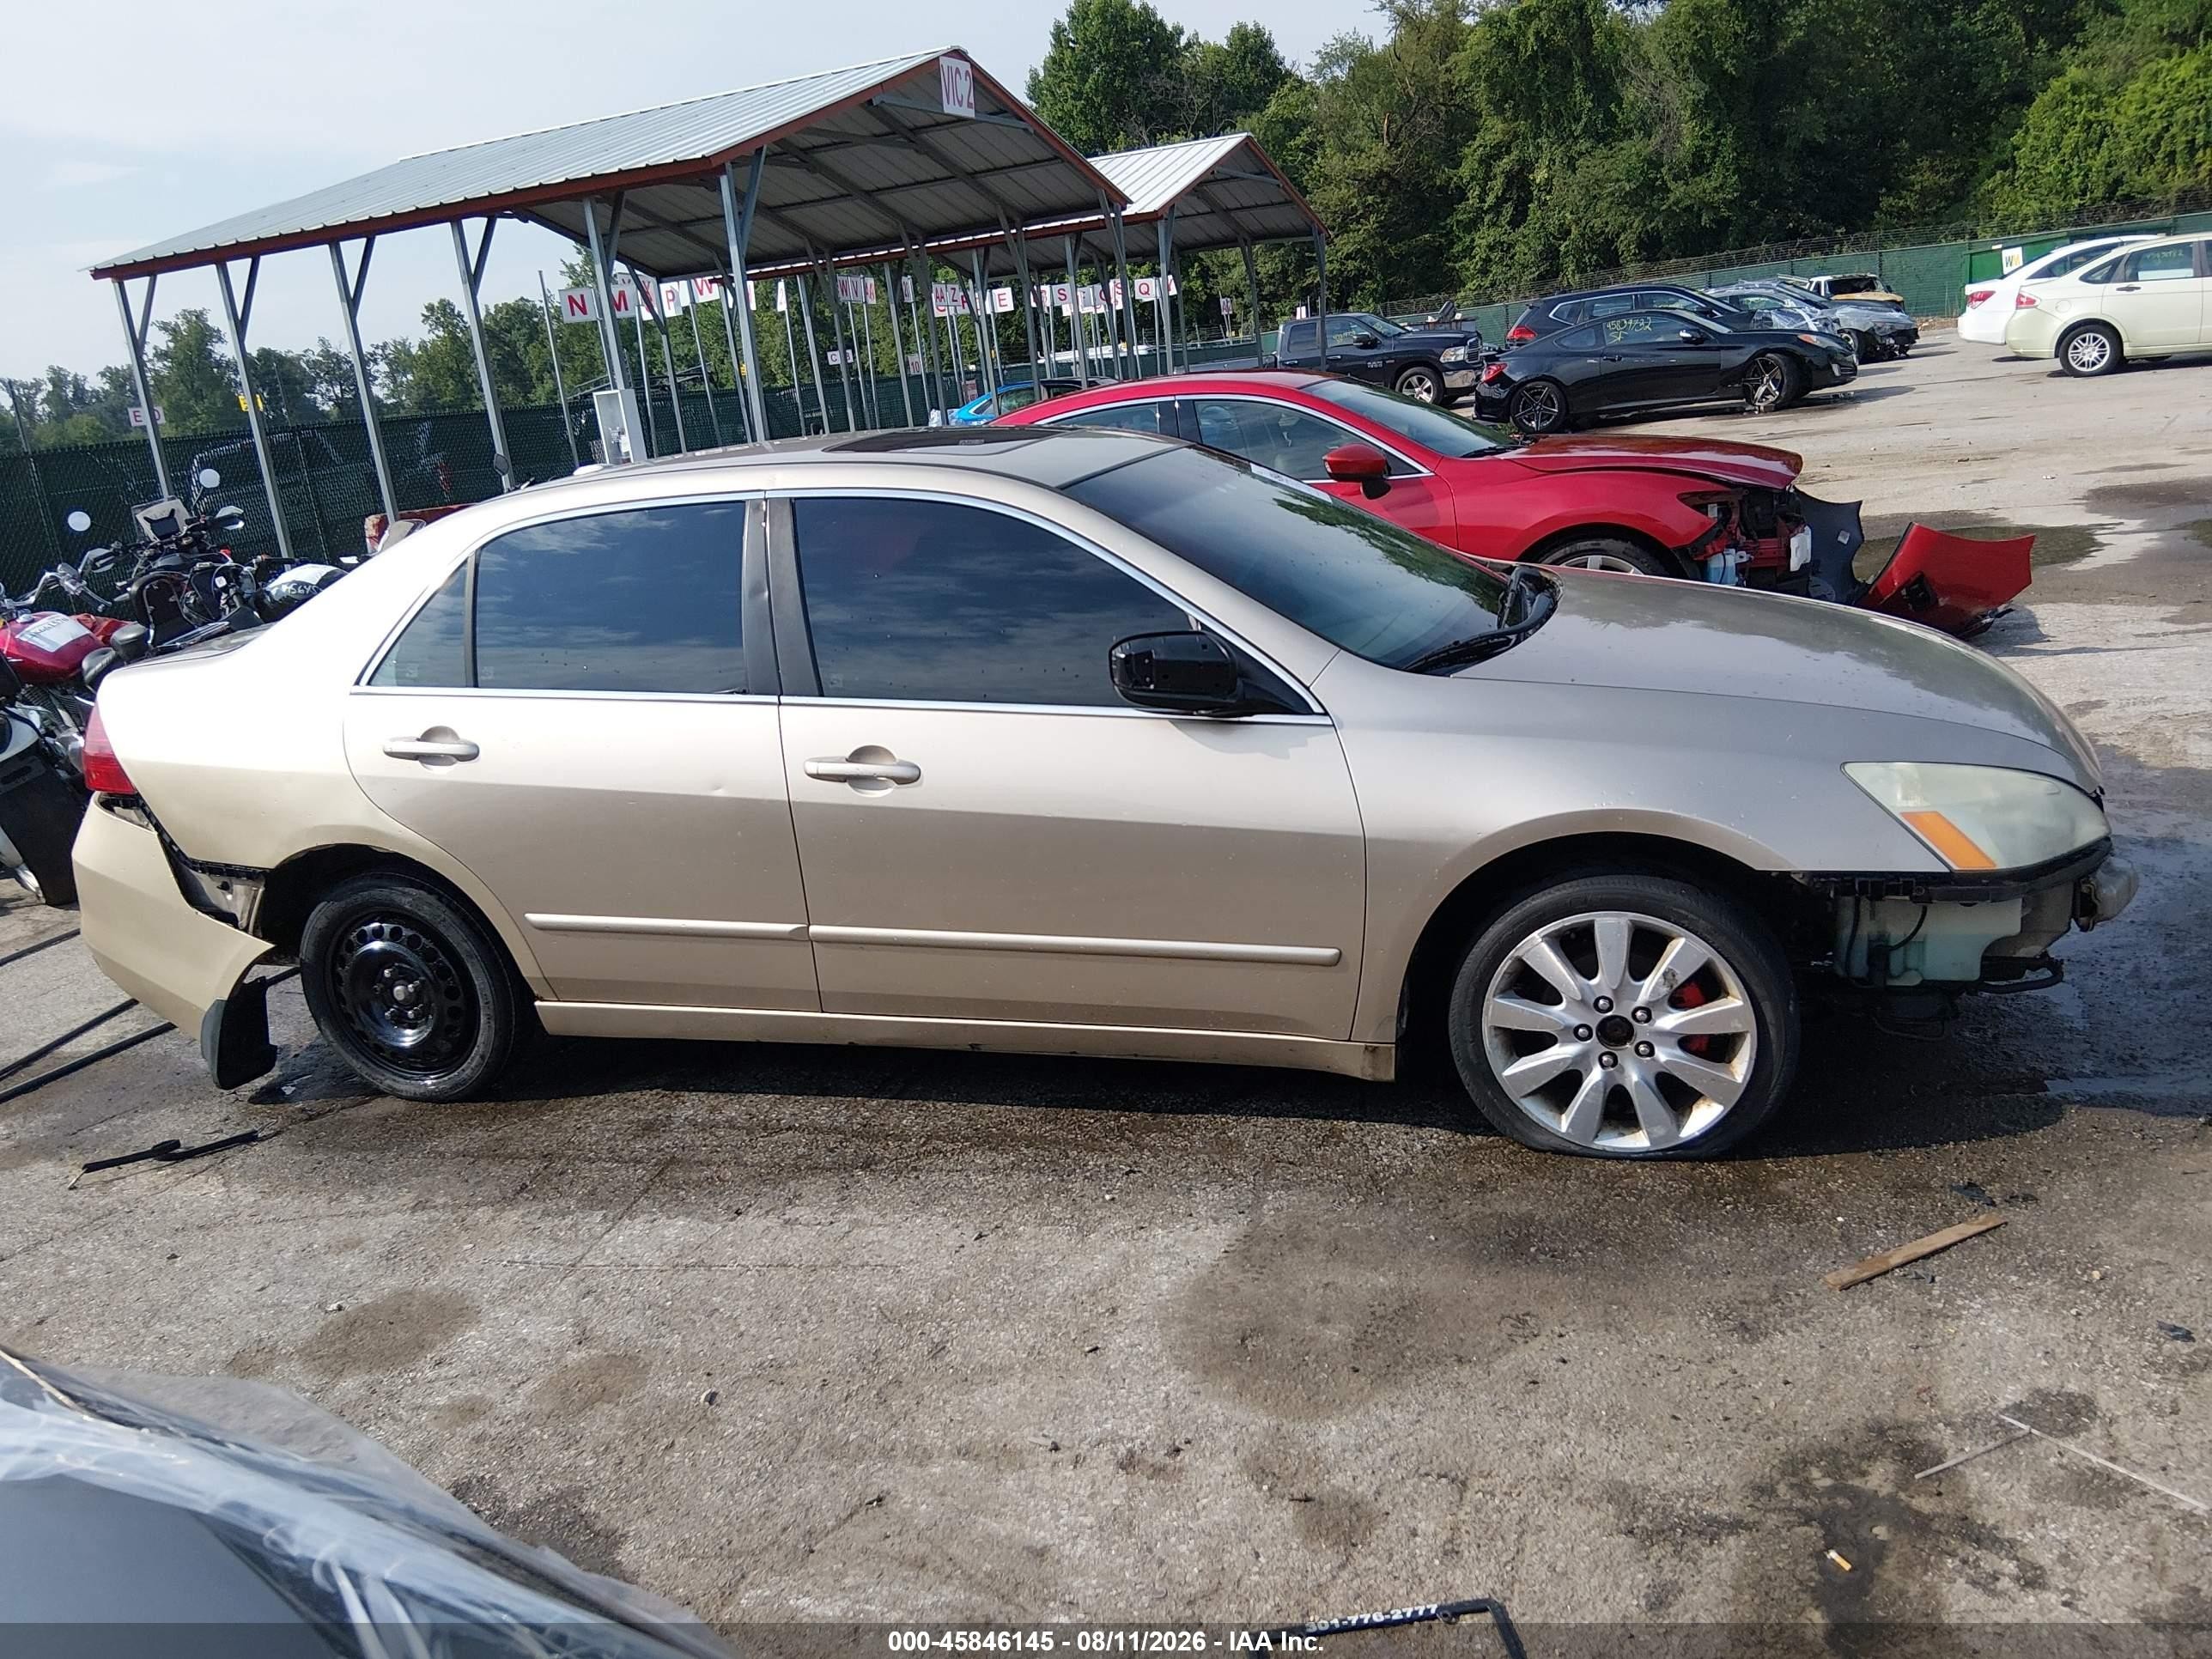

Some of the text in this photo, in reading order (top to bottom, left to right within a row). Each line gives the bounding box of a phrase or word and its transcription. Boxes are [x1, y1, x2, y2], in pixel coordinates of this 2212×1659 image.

[941, 64, 974, 109] VIC 2
[950, 287, 958, 302] Z
[1057, 288, 1067, 301] S
[1139, 282, 1151, 295] Q
[568, 294, 588, 316] N
[997, 292, 1008, 307] E
[132, 410, 143, 422] E
[1305, 1603, 1437, 1632] 301-776-2777
